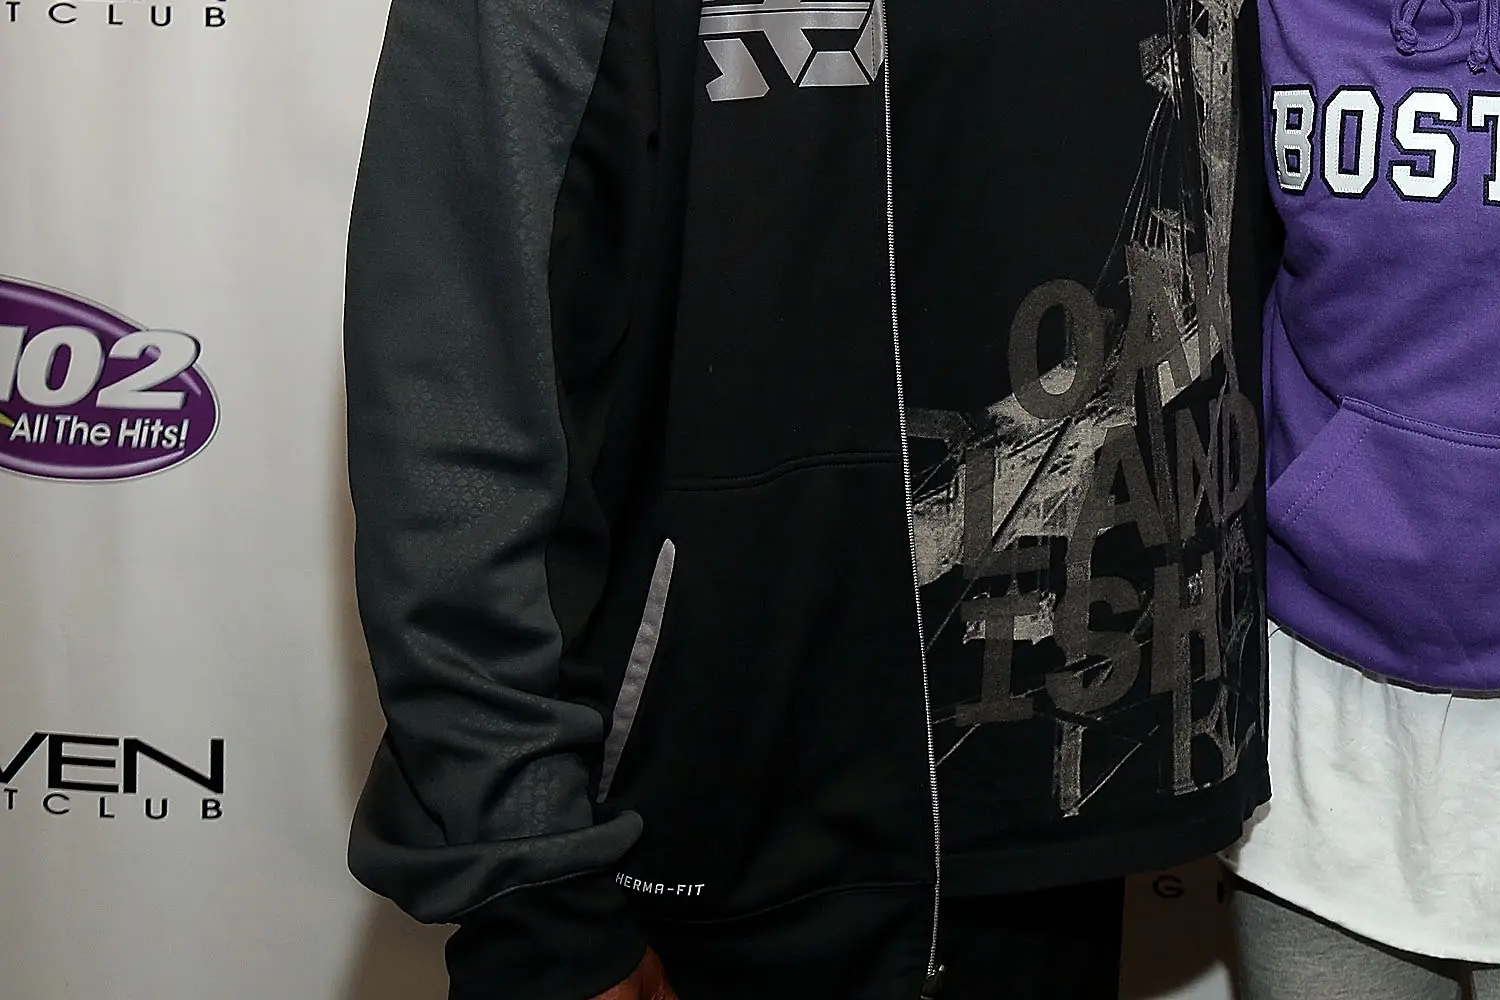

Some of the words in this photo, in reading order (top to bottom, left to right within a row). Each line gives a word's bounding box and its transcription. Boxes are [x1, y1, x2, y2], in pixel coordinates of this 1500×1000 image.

[6, 1, 226, 27] TCLUB
[9, 412, 49, 443] All
[55, 414, 111, 447] The
[117, 417, 189, 449] Hits!
[4, 788, 223, 820] TCLUB
[615, 871, 705, 896] HERMA-FIT
